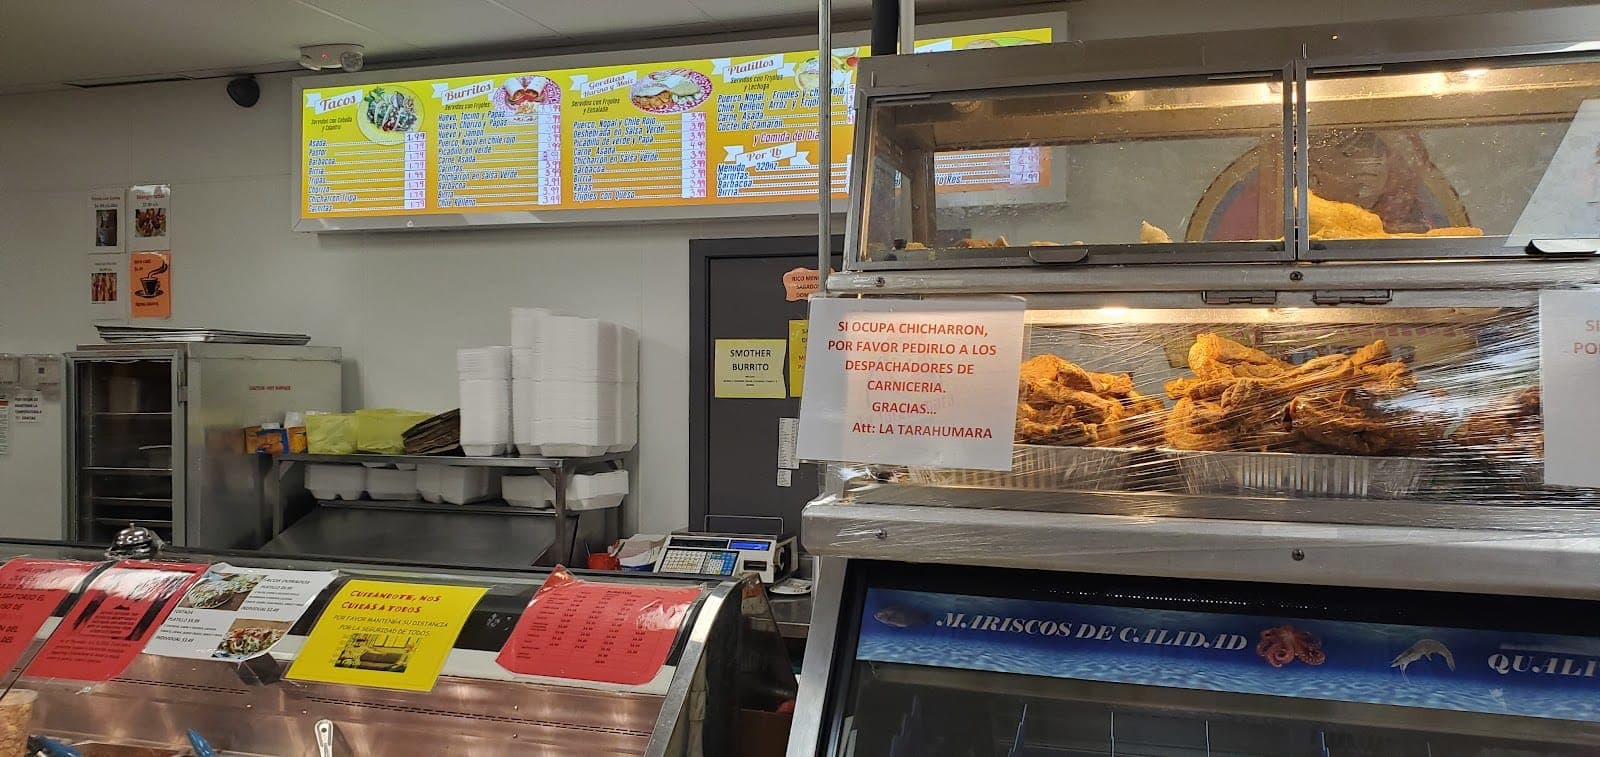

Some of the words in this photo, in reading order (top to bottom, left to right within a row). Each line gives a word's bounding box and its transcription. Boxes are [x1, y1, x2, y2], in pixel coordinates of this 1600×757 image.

[727, 59, 774, 76] Platillos
[445, 83, 491, 101] Burritos
[320, 95, 356, 111] Tacos
[718, 94, 741, 103] Puerco
[718, 103, 734, 112] Chile
[739, 102, 765, 112] Relleno
[769, 100, 787, 109] Arroz
[642, 116, 656, 125] Rojo
[718, 113, 737, 122] Carne
[742, 112, 764, 120] Asada
[741, 121, 750, 130] de
[574, 129, 610, 138] Deshebrada
[625, 127, 642, 135] Salsa
[647, 125, 665, 134] Verde
[602, 137, 609, 145] de
[753, 135, 758, 146] y
[761, 132, 790, 142] Comida
[793, 130, 805, 140] del
[574, 147, 592, 156] Carne
[596, 147, 616, 155] Asada
[747, 151, 766, 161] Por
[458, 155, 476, 163] Asada
[620, 154, 637, 162] Salsa
[574, 165, 605, 174] Barbacoa
[718, 163, 745, 173] Menudo
[574, 174, 592, 182] Birria
[718, 172, 748, 181] Carnitas
[574, 183, 592, 192] Rajas
[718, 179, 752, 188] Barbacoa
[615, 190, 635, 199] Queso
[718, 188, 738, 197] Birria
[838, 321, 848, 332] SI
[852, 321, 895, 333] OCUPA
[899, 323, 988, 337] CHICHARRON,
[828, 340, 852, 351] POR
[857, 341, 898, 353] FAVOR
[902, 343, 955, 354] PEDIRLO
[959, 344, 968, 355] A
[972, 344, 997, 355] LOS
[730, 349, 771, 357] SMOTHER
[732, 363, 769, 371] BURRITO
[845, 360, 952, 374] DESPACHADORES
[958, 364, 974, 375] DE
[867, 380, 946, 393] CARNICERIA.
[872, 401, 937, 415] GRACIAS...
[853, 422, 875, 434] Att:
[879, 423, 894, 435] LA
[898, 424, 993, 439] TARAHUMARA
[388, 605, 422, 613] TODOS
[936, 612, 1073, 637] MARISCOS
[1075, 623, 1117, 641] DE
[1119, 626, 1248, 650] CALIDAD
[1487, 653, 1600, 677] QUALI
